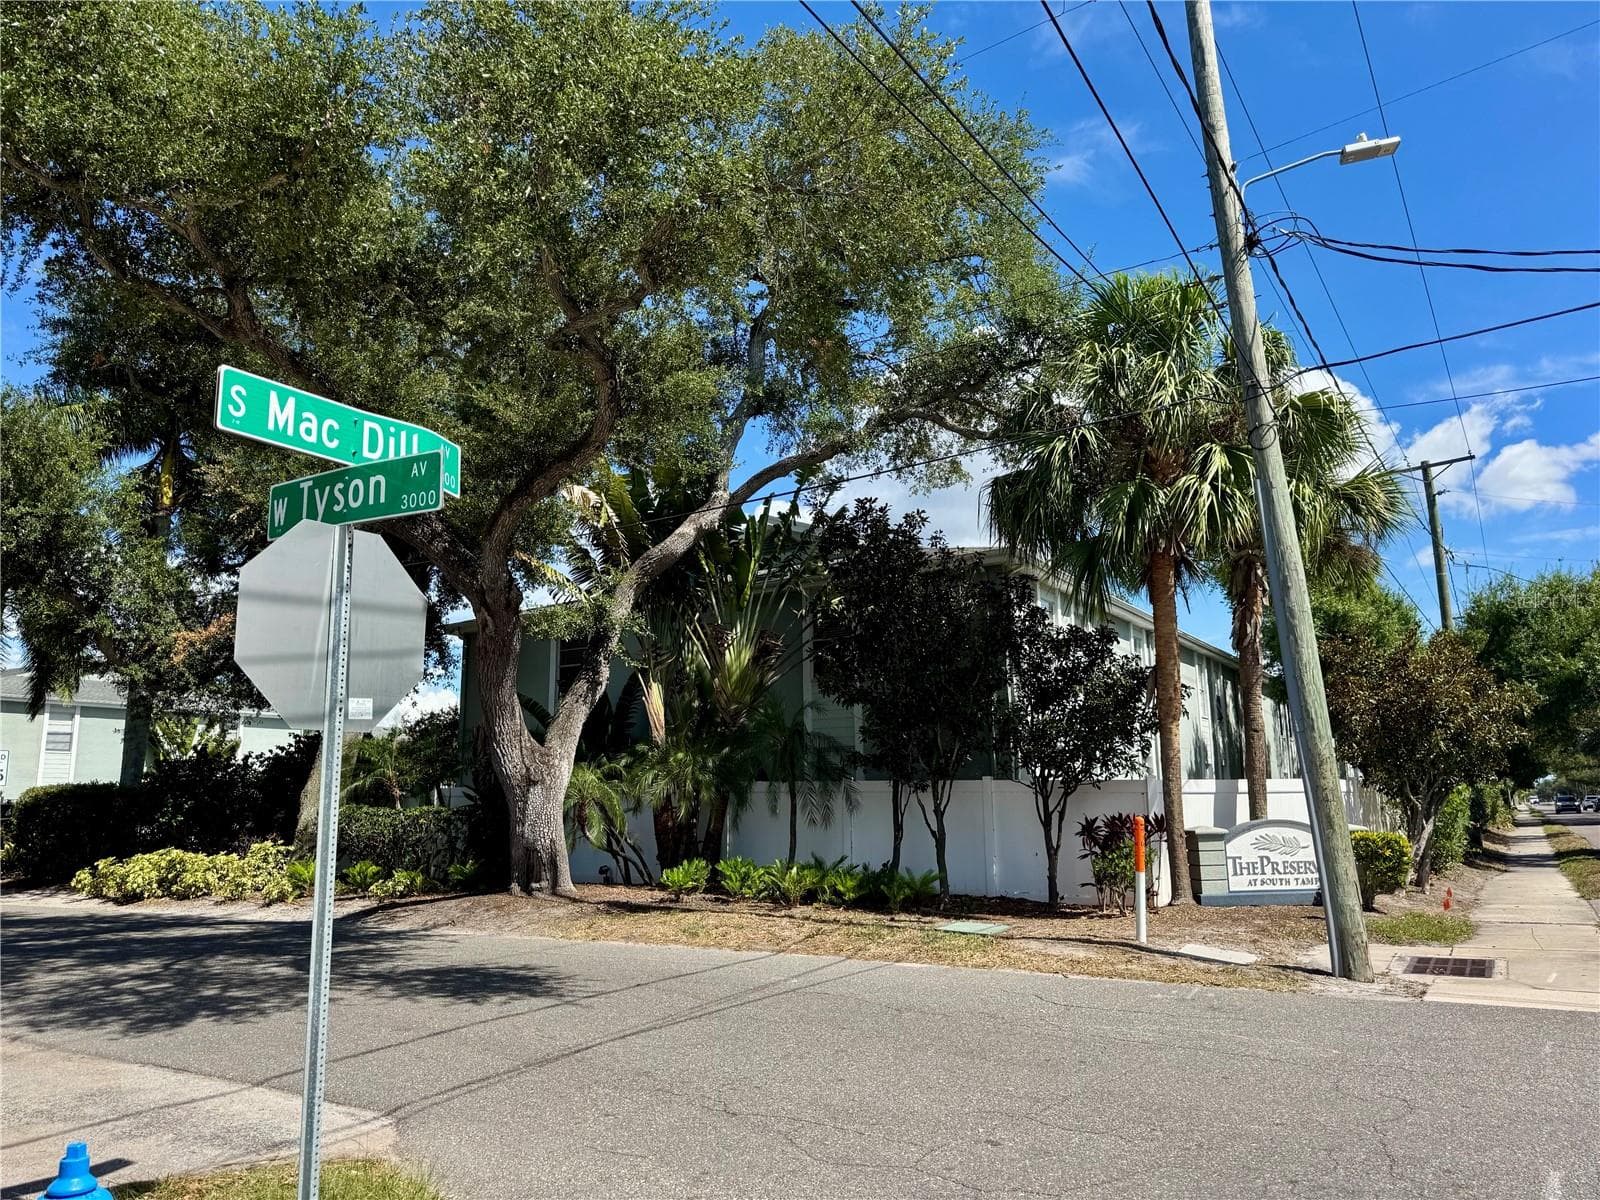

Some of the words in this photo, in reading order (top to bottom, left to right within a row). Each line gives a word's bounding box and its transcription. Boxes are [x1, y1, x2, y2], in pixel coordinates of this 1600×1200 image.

[228, 384, 247, 418] S
[267, 390, 340, 449] Mac
[411, 460, 427, 478] AV
[444, 472, 456, 489] 00
[273, 496, 288, 528] W
[300, 474, 386, 522] Tyson
[400, 489, 436, 509] 3000
[1247, 878, 1258, 887] AT
[1260, 877, 1290, 887] SOUTH
[1295, 877, 1320, 886] TAMP
